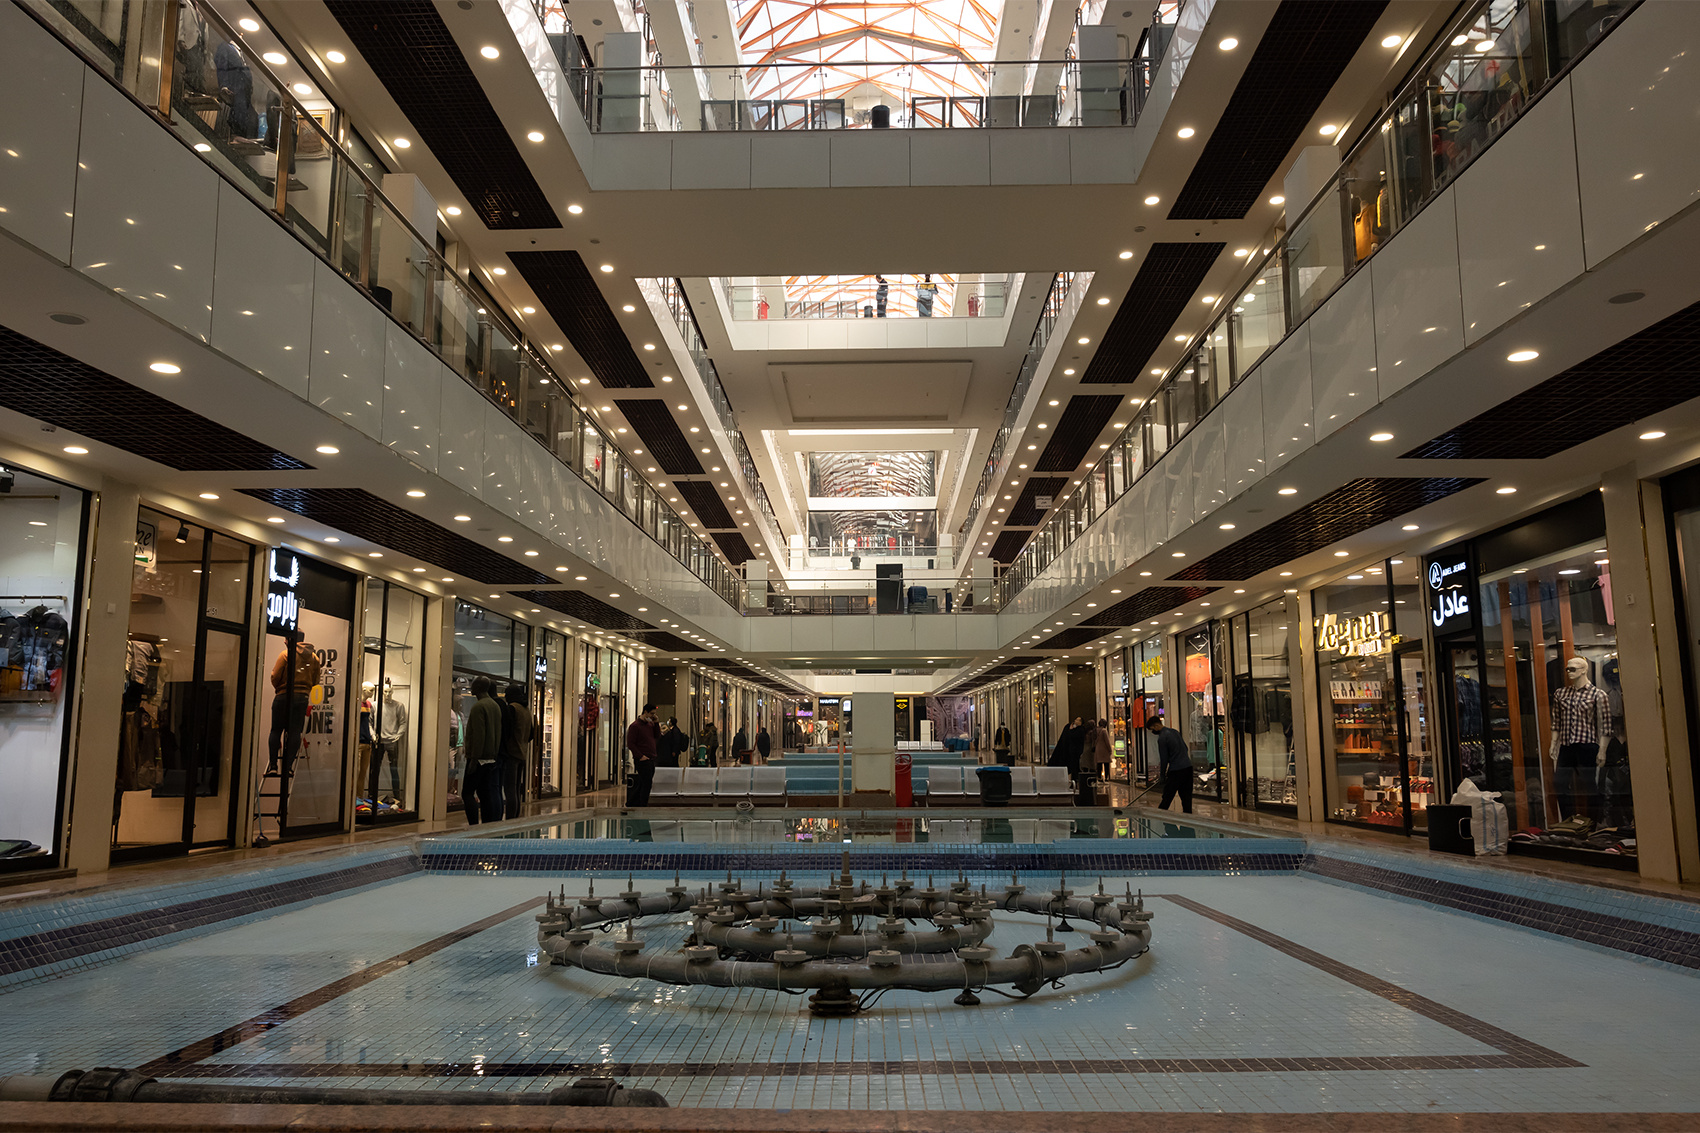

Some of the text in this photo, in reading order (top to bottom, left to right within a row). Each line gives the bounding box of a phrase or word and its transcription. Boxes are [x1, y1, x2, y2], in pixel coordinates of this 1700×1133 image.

[1432, 590, 1469, 627] عادل
[316, 648, 338, 668] OP
[310, 684, 335, 704] OP
